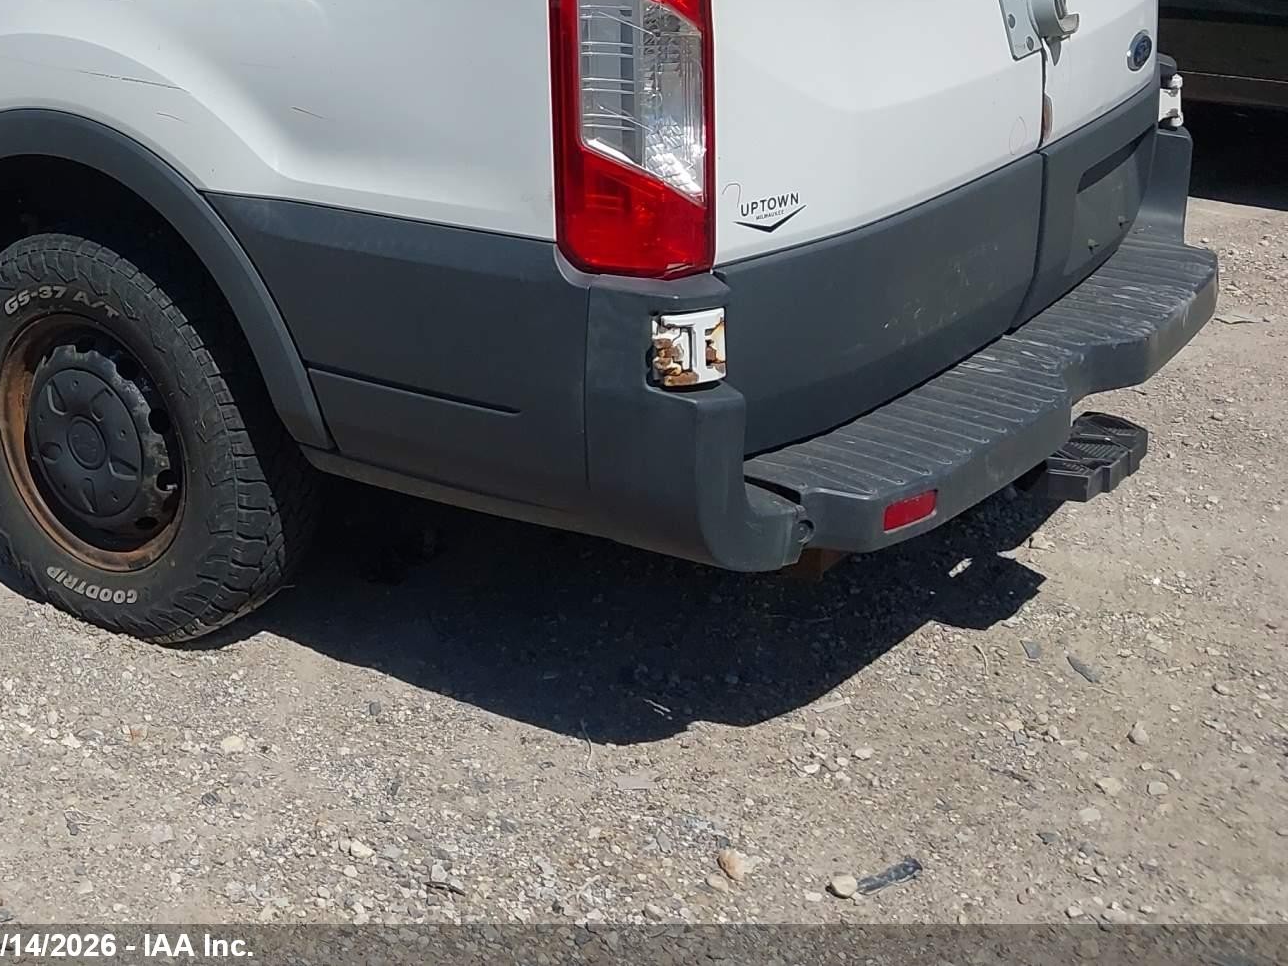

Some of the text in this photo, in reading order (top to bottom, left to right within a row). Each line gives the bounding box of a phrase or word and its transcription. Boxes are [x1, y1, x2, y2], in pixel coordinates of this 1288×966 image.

[740, 192, 799, 217] UPTOWN
[4, 285, 120, 319] GS-37 A/T
[46, 566, 138, 604] GOODTRIP
